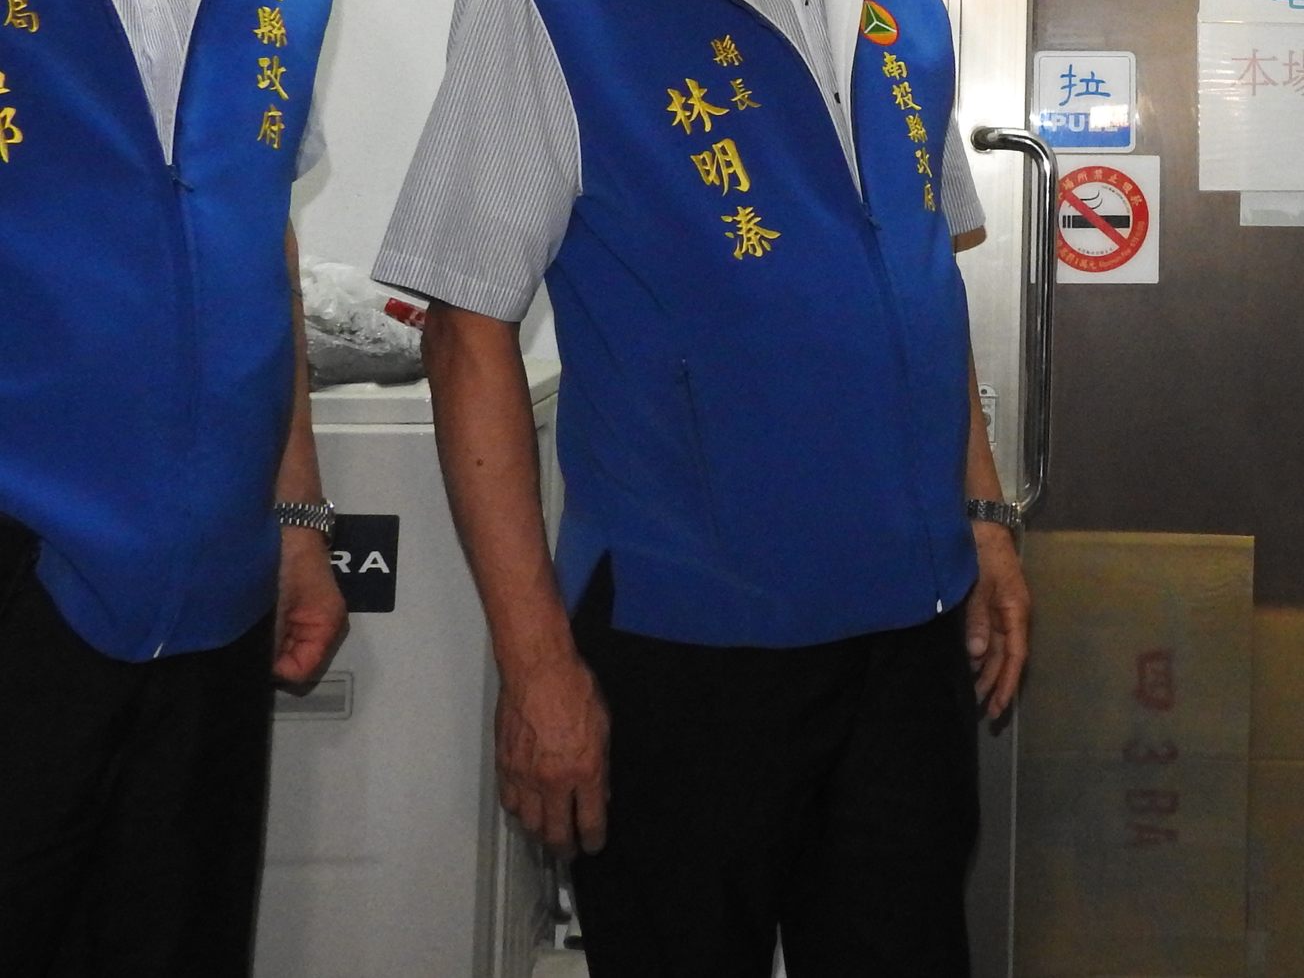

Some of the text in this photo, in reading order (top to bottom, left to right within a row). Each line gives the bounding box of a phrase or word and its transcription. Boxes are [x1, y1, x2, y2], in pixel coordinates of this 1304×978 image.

[710, 34, 762, 112] 縣長
[1059, 63, 1112, 107] 拉
[882, 51, 937, 212] 南投縣政府
[1051, 114, 1118, 133] PU
[666, 78, 782, 261] 林明溱
